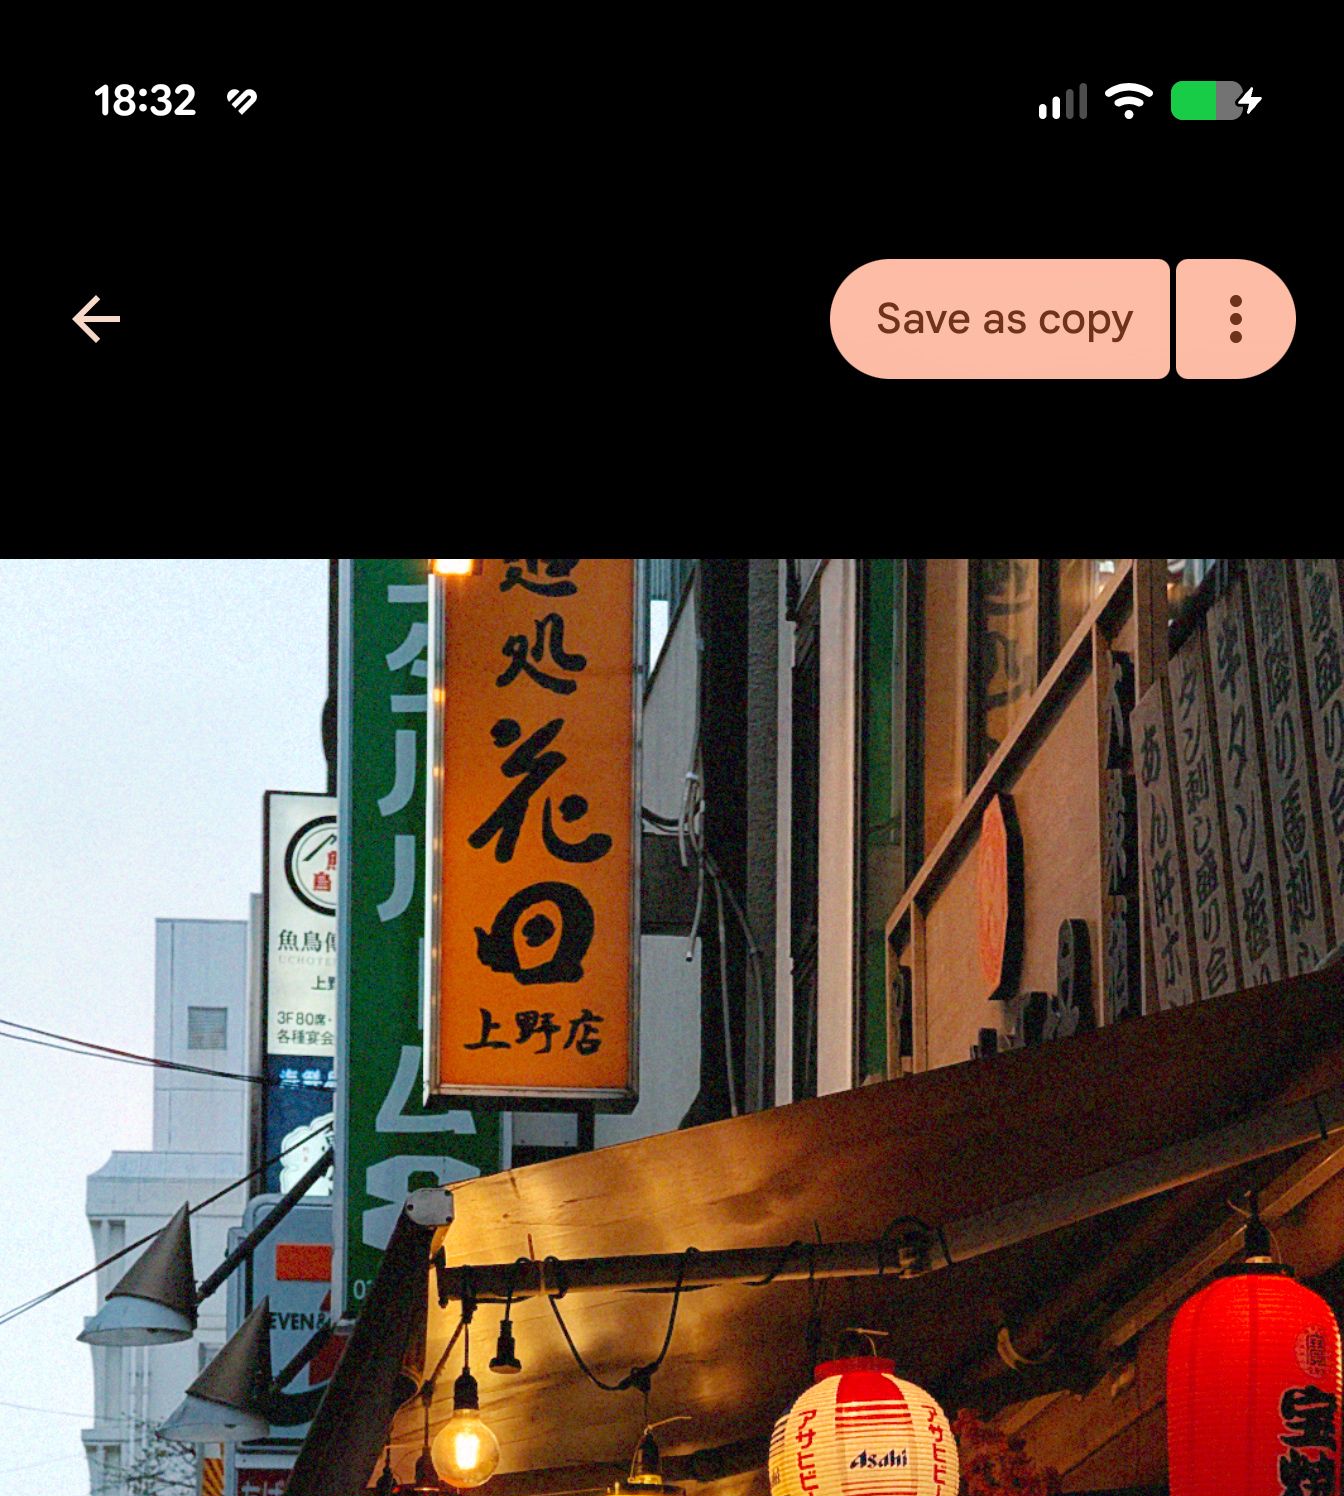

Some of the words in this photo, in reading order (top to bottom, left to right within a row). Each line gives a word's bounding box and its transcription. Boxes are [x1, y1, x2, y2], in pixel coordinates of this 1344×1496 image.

[95, 84, 196, 116] 18:32
[878, 302, 969, 334] Save
[984, 310, 1026, 334] as
[1040, 310, 1133, 342] copy
[277, 1028, 334, 1045] 各種宴会
[463, 1006, 605, 1056] 上野店
[269, 1311, 331, 1330] EVEN&
[850, 1449, 907, 1470] Asahi
